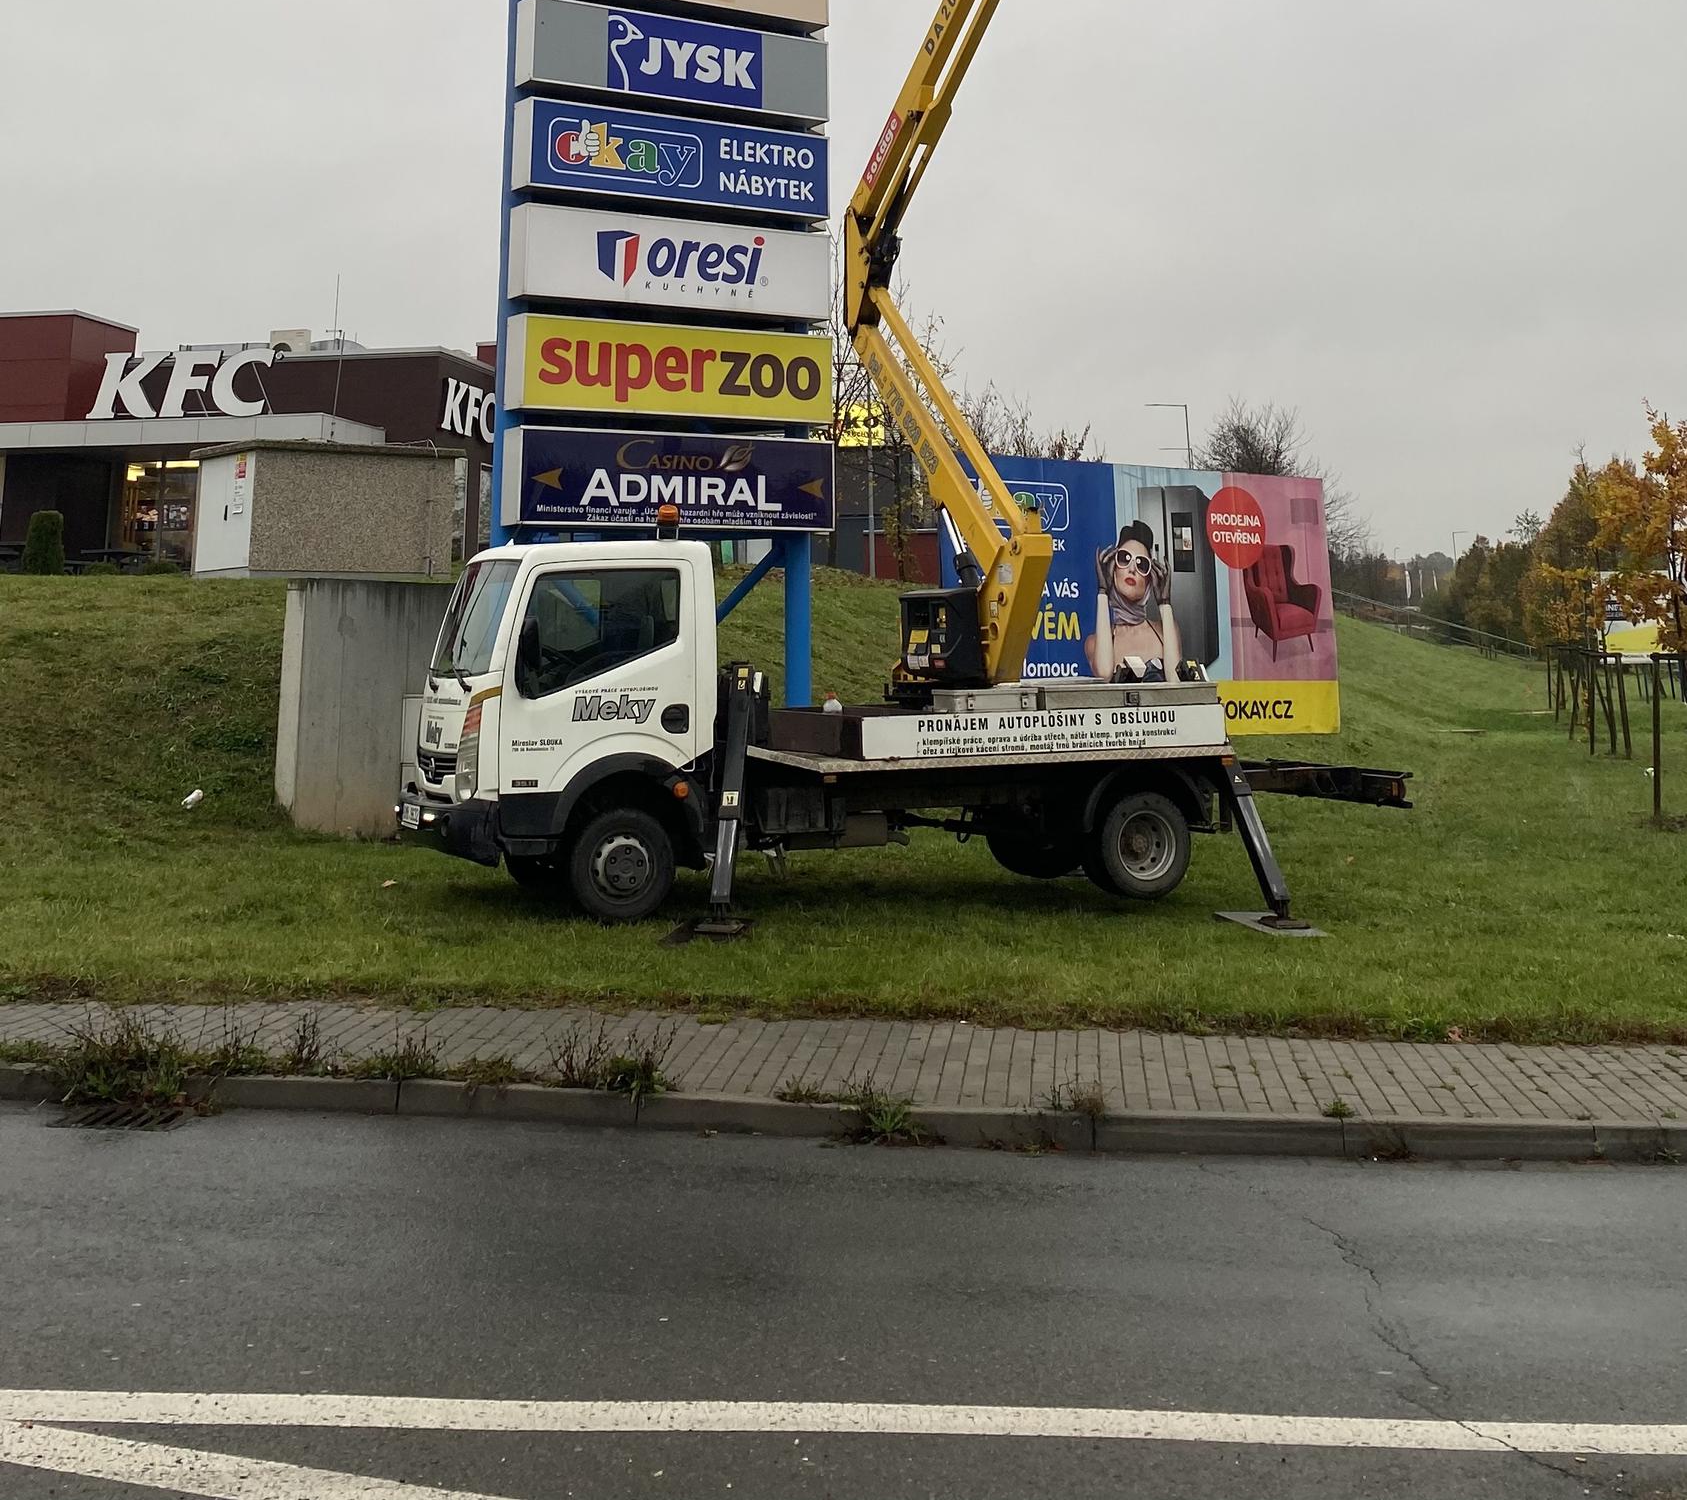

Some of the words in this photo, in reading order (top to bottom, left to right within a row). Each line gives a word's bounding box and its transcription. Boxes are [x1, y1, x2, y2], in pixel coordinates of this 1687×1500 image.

[639, 36, 757, 91] JYSK
[719, 137, 815, 170] ELEKTRO
[866, 118, 898, 184] socage
[719, 168, 815, 202] NÁBYTEK
[646, 236, 766, 286] oresi
[86, 348, 276, 420] KFC
[537, 337, 822, 403] superzoo
[441, 377, 496, 444] KFC
[615, 439, 713, 471] CASINO
[580, 468, 783, 512] ADMIRAL
[536, 504, 584, 514] Ministerstvo
[586, 505, 612, 515] financí
[680, 508, 710, 517] hazardní
[712, 509, 724, 518] hře
[745, 511, 780, 519] vzniknout
[586, 514, 609, 522] Zákaz
[692, 517, 721, 525] osobám
[1210, 513, 1261, 528] PRODEJNA
[1212, 529, 1262, 545] OTEVŘENA
[1053, 577, 1080, 599] VÁS
[1031, 603, 1081, 641] VÉM
[1022, 657, 1079, 678] lomouc
[571, 694, 657, 725] Meky
[918, 714, 989, 733] PRONÁJEM
[998, 711, 1086, 730] AUTOPLOŠINY
[1094, 713, 1102, 726] S
[1111, 710, 1176, 725] OBSLUHOU
[1226, 699, 1294, 720] OKAY.CZ
[511, 739, 538, 747] Miroslav
[539, 738, 563, 746] SLOUKA
[987, 735, 1011, 745] oprava
